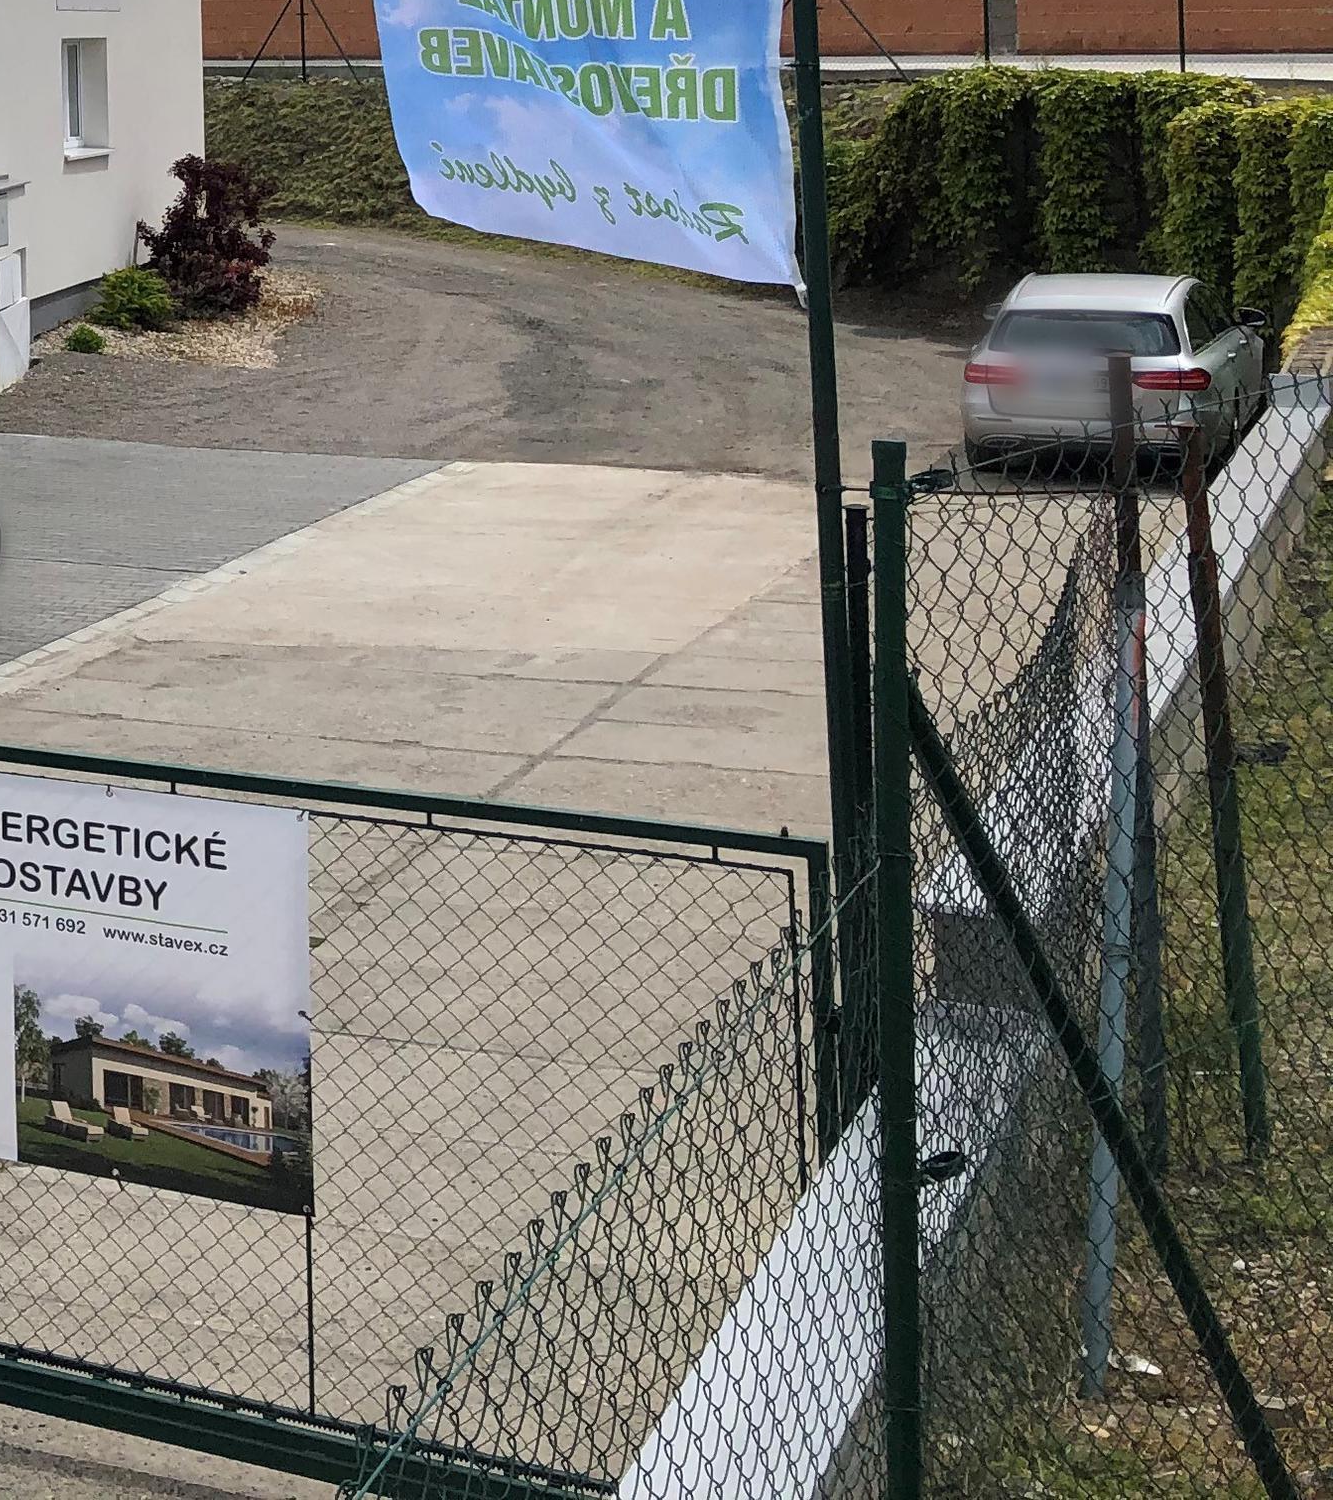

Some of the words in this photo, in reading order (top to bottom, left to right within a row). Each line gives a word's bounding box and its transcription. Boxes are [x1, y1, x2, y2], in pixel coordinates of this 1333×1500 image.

[22, 912, 50, 930] 571
[55, 917, 86, 935] 692
[103, 925, 229, 956] www.stavex.cz
